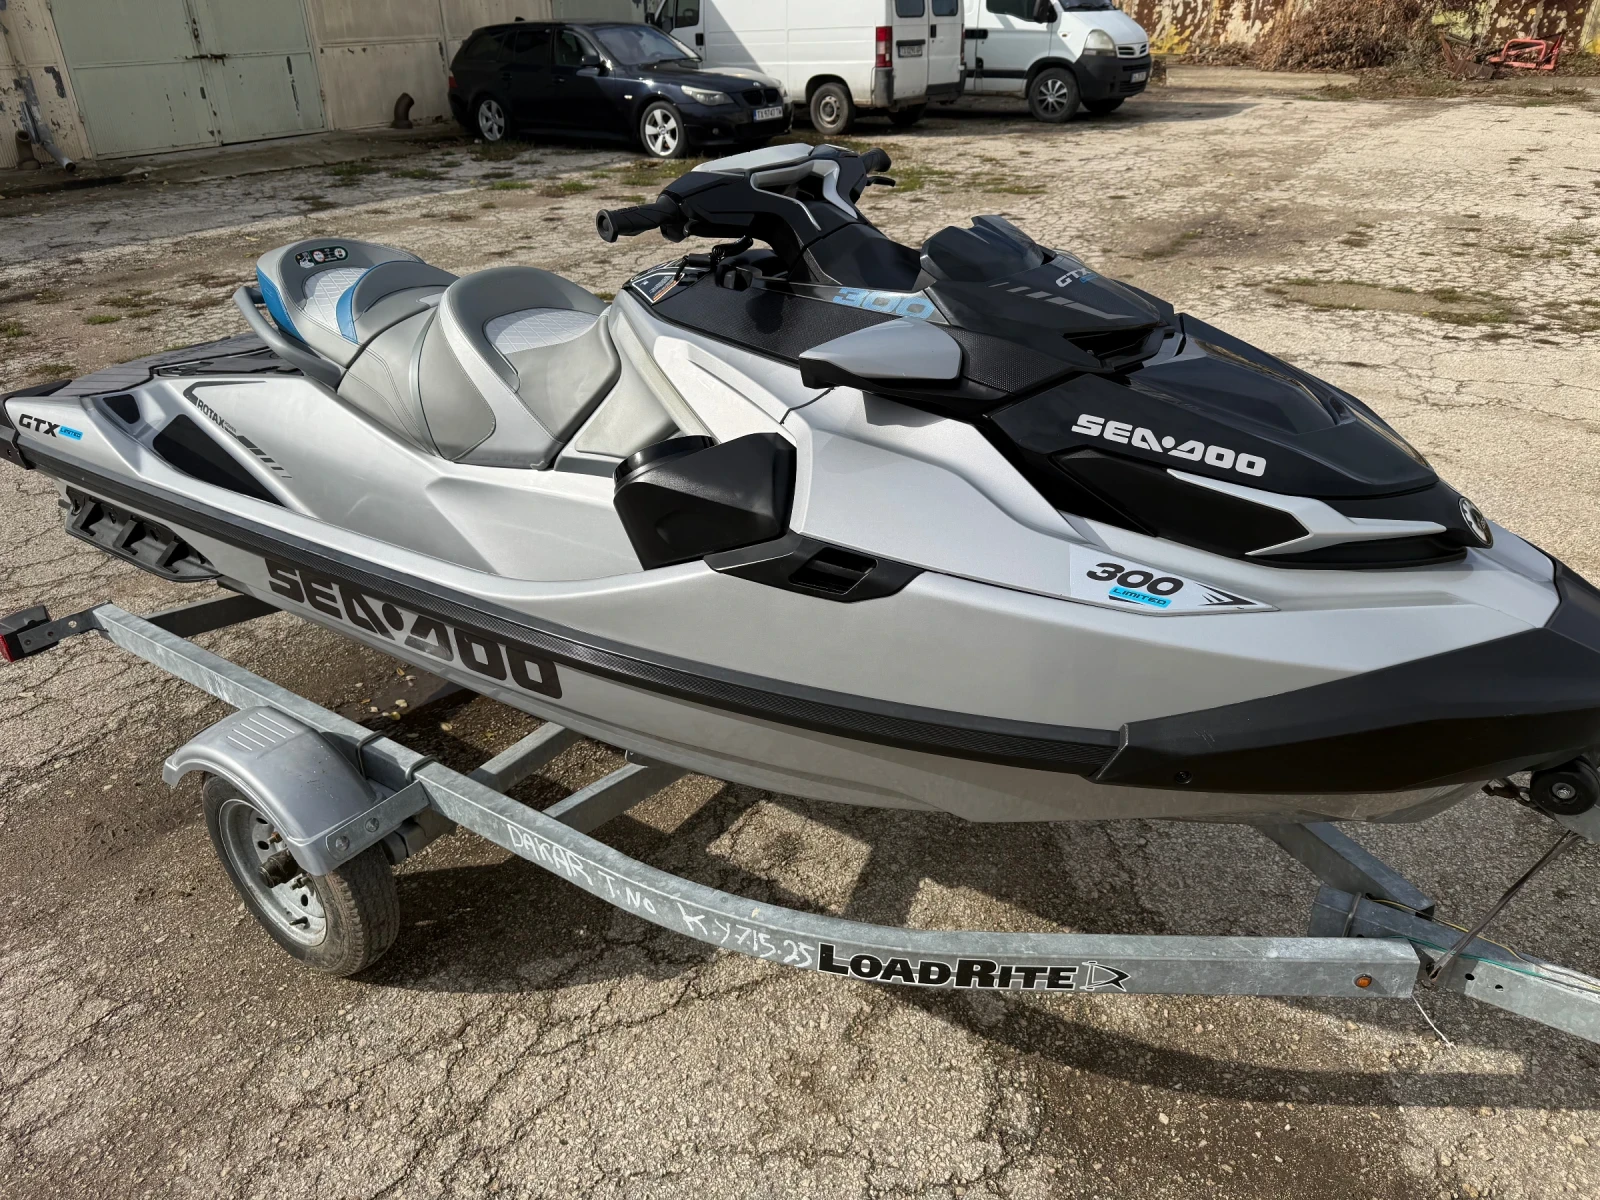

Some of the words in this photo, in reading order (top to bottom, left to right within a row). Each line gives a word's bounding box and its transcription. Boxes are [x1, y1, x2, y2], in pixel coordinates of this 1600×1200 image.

[1056, 267, 1091, 288] GTX
[832, 287, 936, 319] 300
[19, 413, 60, 438] GTX
[197, 399, 225, 429] ROTAX
[1086, 562, 1184, 596] 300
[1112, 588, 1169, 607] LIMITED
[507, 823, 594, 887] DAKAR
